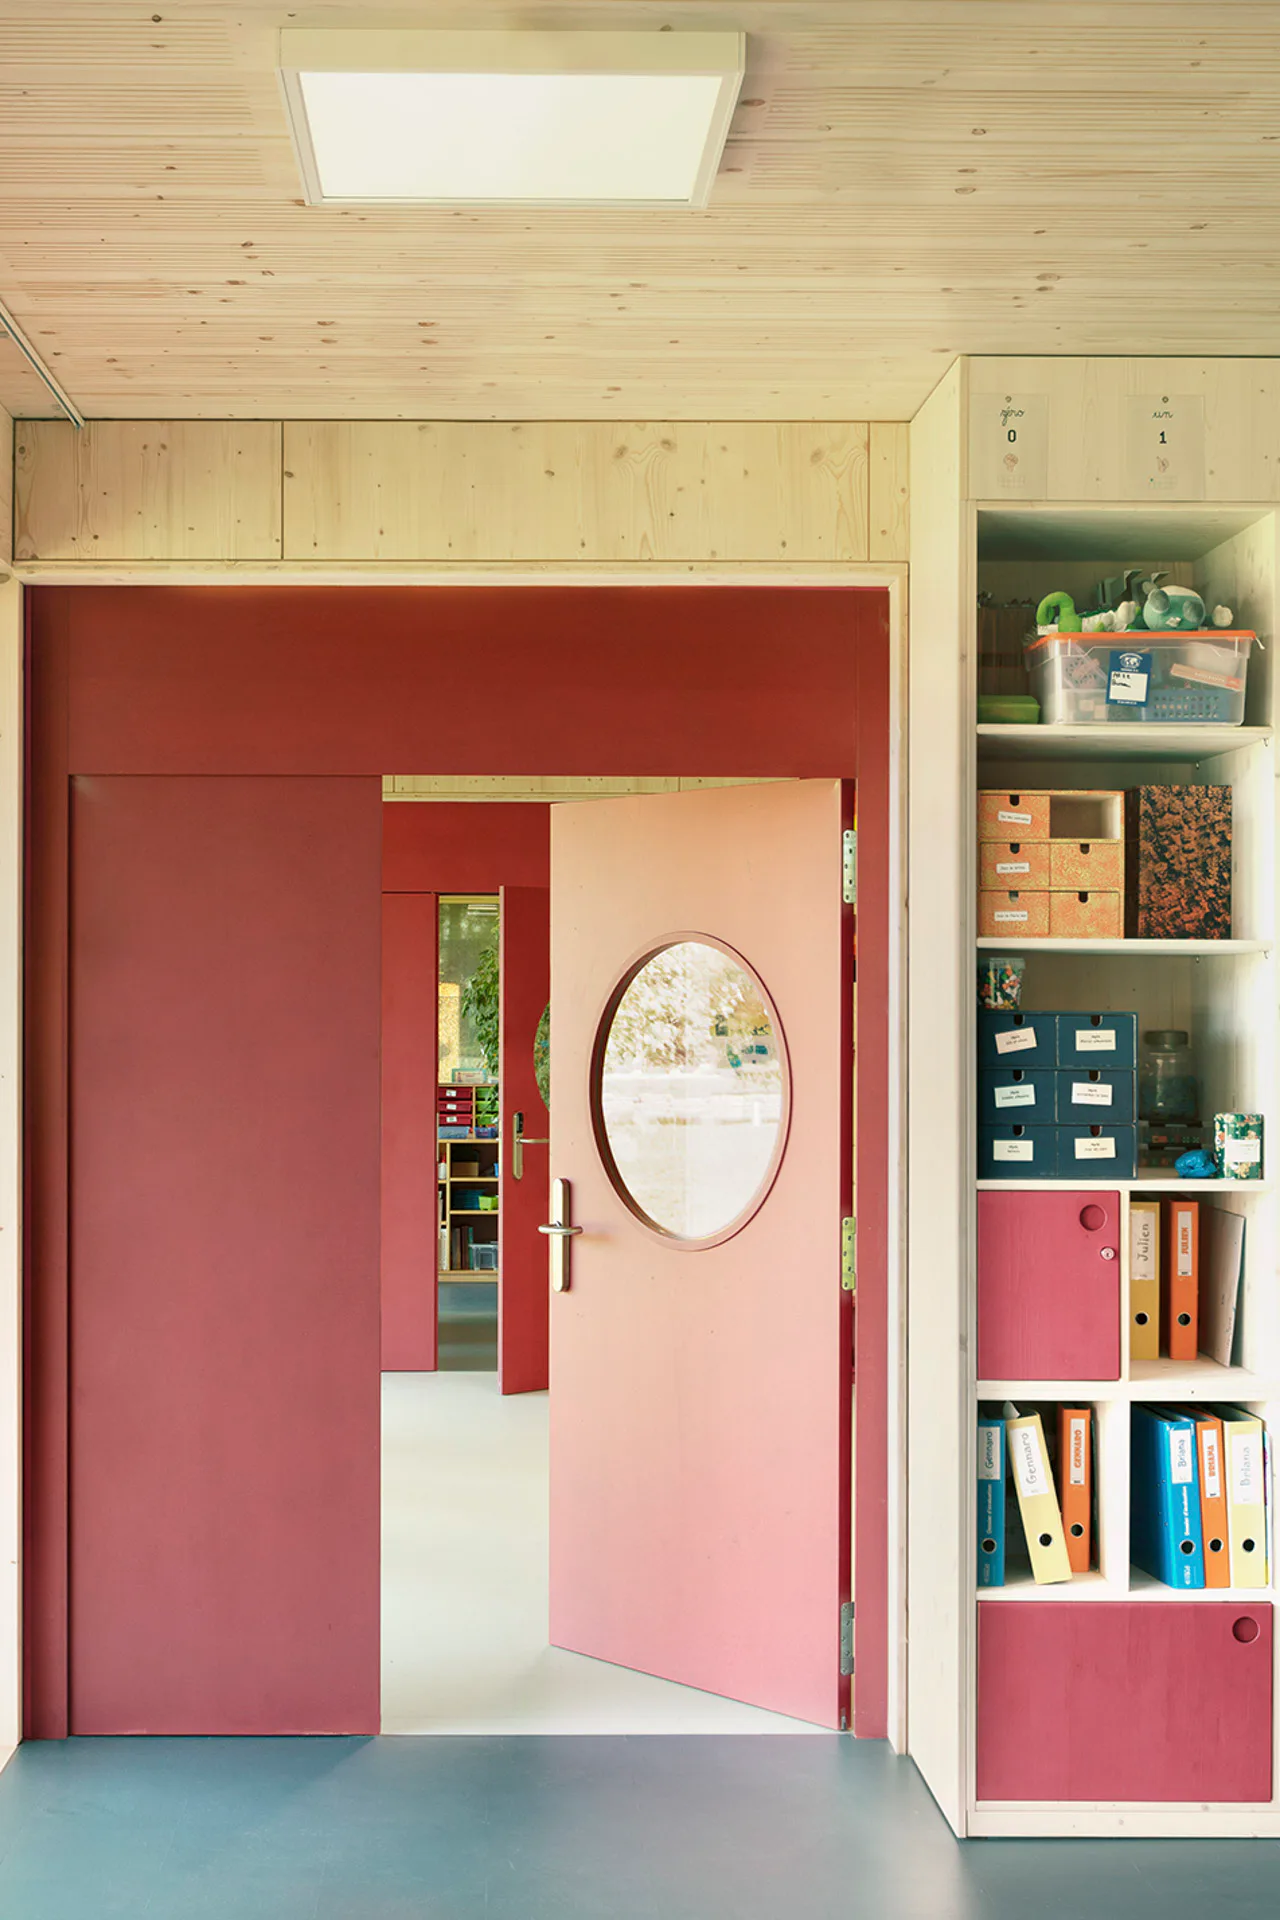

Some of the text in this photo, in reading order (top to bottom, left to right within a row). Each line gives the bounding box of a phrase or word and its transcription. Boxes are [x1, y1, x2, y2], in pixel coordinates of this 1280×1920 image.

[1152, 411, 1174, 419] un
[1007, 429, 1017, 443] 0
[1159, 431, 1167, 444] 1
[1137, 1223, 1150, 1262] Julien
[1181, 1227, 1189, 1255] JULIEN
[985, 1431, 993, 1469] Gennaro
[1025, 1432, 1038, 1485] Gennaro
[1074, 1429, 1082, 1469] GENNARO
[1177, 1439, 1187, 1468] Briana
[1206, 1445, 1216, 1477] BRIANA
[1239, 1446, 1251, 1487] Briana
